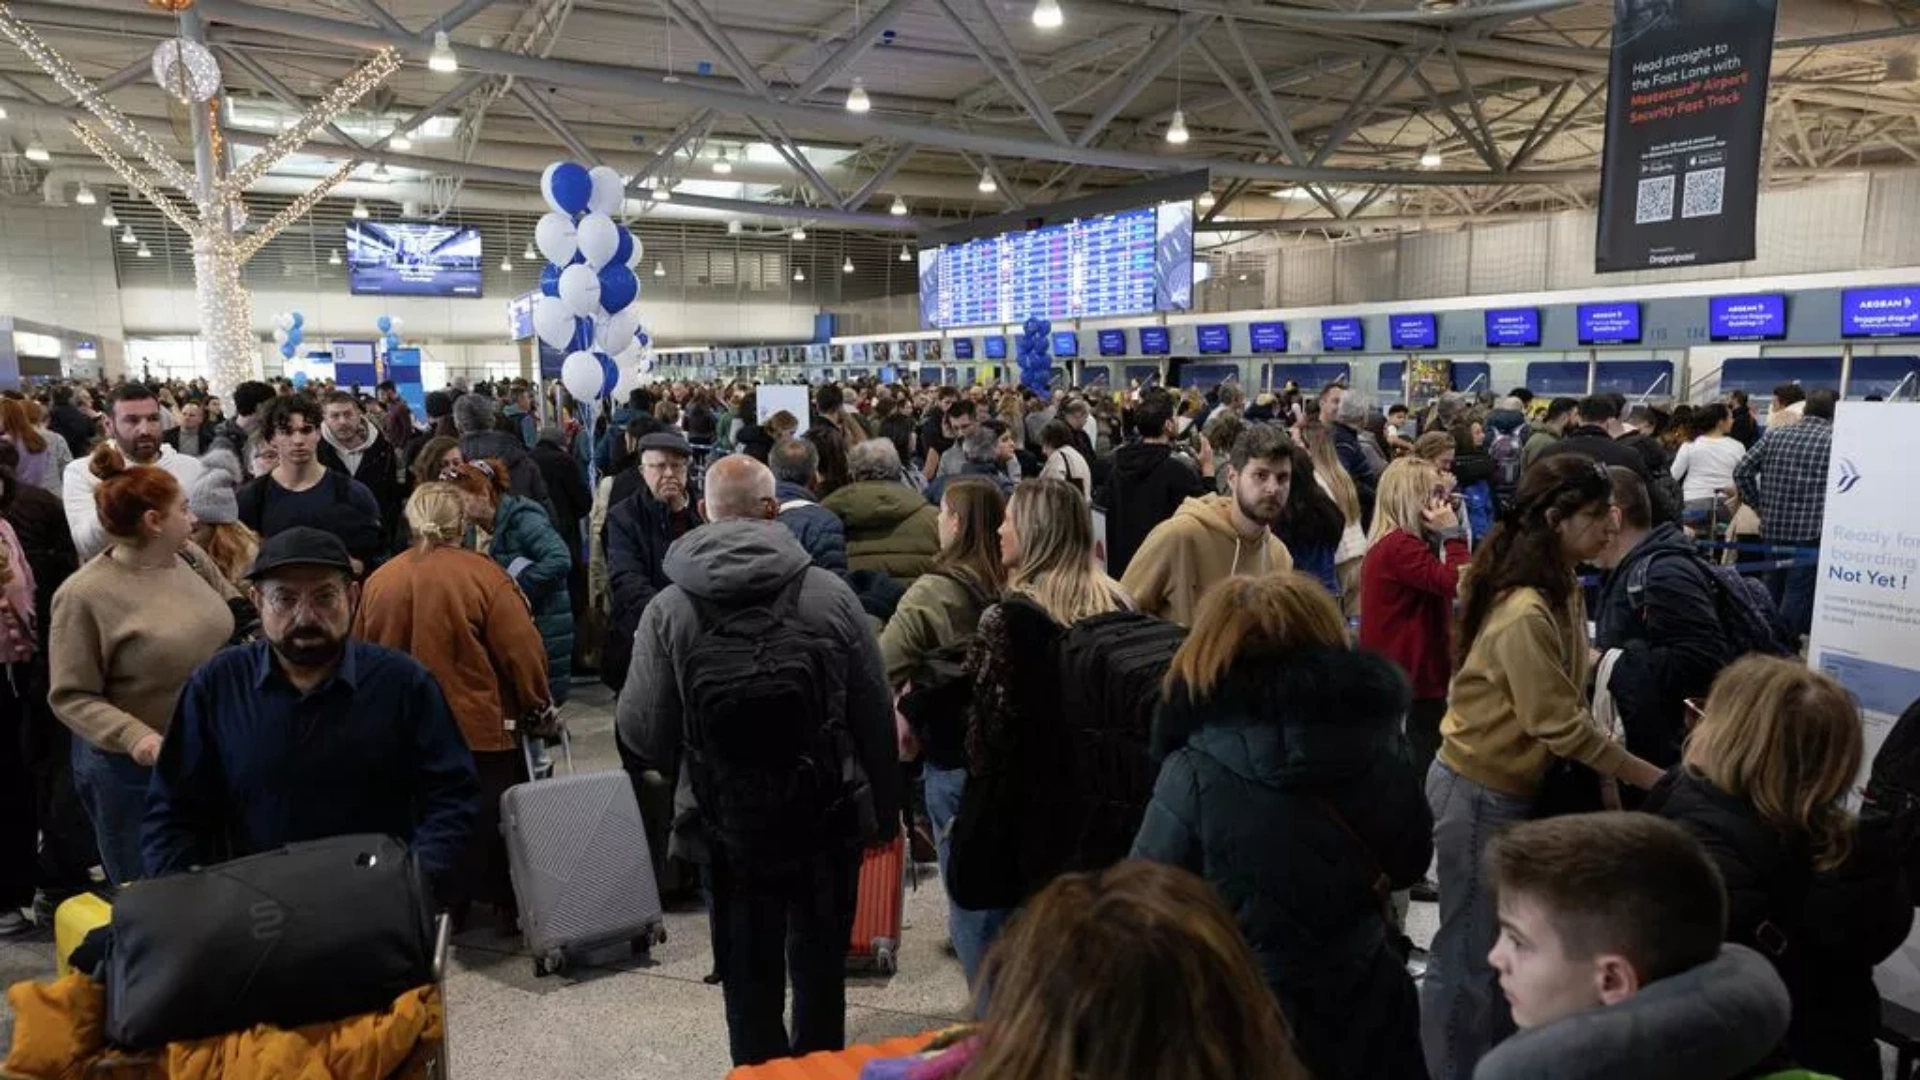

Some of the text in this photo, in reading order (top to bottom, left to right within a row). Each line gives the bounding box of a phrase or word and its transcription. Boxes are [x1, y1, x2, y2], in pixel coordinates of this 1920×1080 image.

[1632, 44, 1729, 75] Head straight to
[1632, 56, 1741, 91] the Fast Lane with
[1703, 70, 1749, 91] Airport
[1629, 91, 1742, 123] Security Fast Track
[1728, 305, 1758, 313] AEGEAN
[1859, 299, 1902, 309] AEGEAN
[1853, 314, 1886, 325] Baggage
[1832, 525, 1890, 548] Ready
[1831, 546, 1916, 573] boarding
[1829, 566, 1908, 590] Not Yet !
